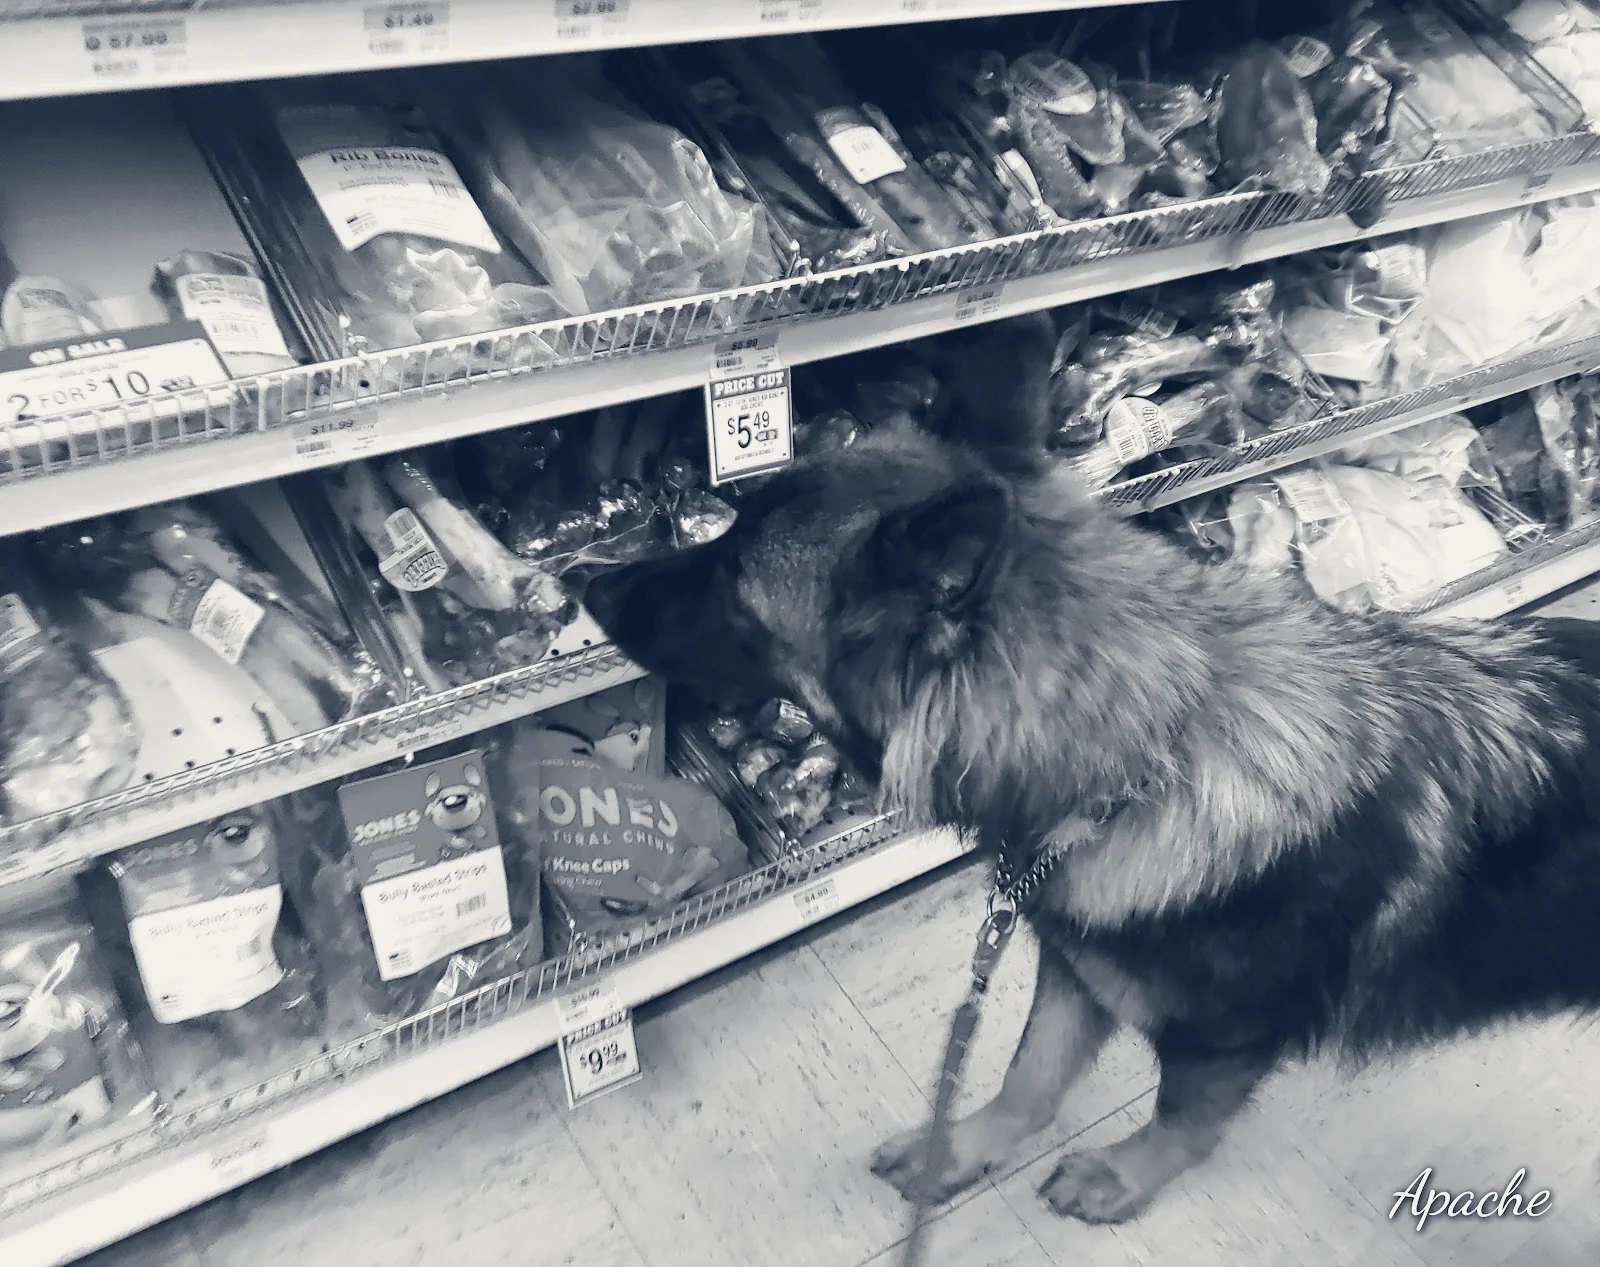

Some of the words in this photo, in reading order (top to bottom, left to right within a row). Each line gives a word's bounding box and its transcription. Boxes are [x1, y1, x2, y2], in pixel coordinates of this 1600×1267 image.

[331, 150, 368, 163] Rib
[373, 149, 439, 165] Bones
[714, 376, 755, 398] PRICE
[757, 371, 785, 390] CUT
[8, 393, 39, 421] 2
[38, 388, 86, 407] FOR
[311, 419, 354, 434] $11.99
[352, 809, 421, 843] JONES
[553, 856, 590, 874] Knee
[591, 857, 631, 875] Caps
[379, 887, 409, 905] Bully
[454, 862, 488, 881] Strips
